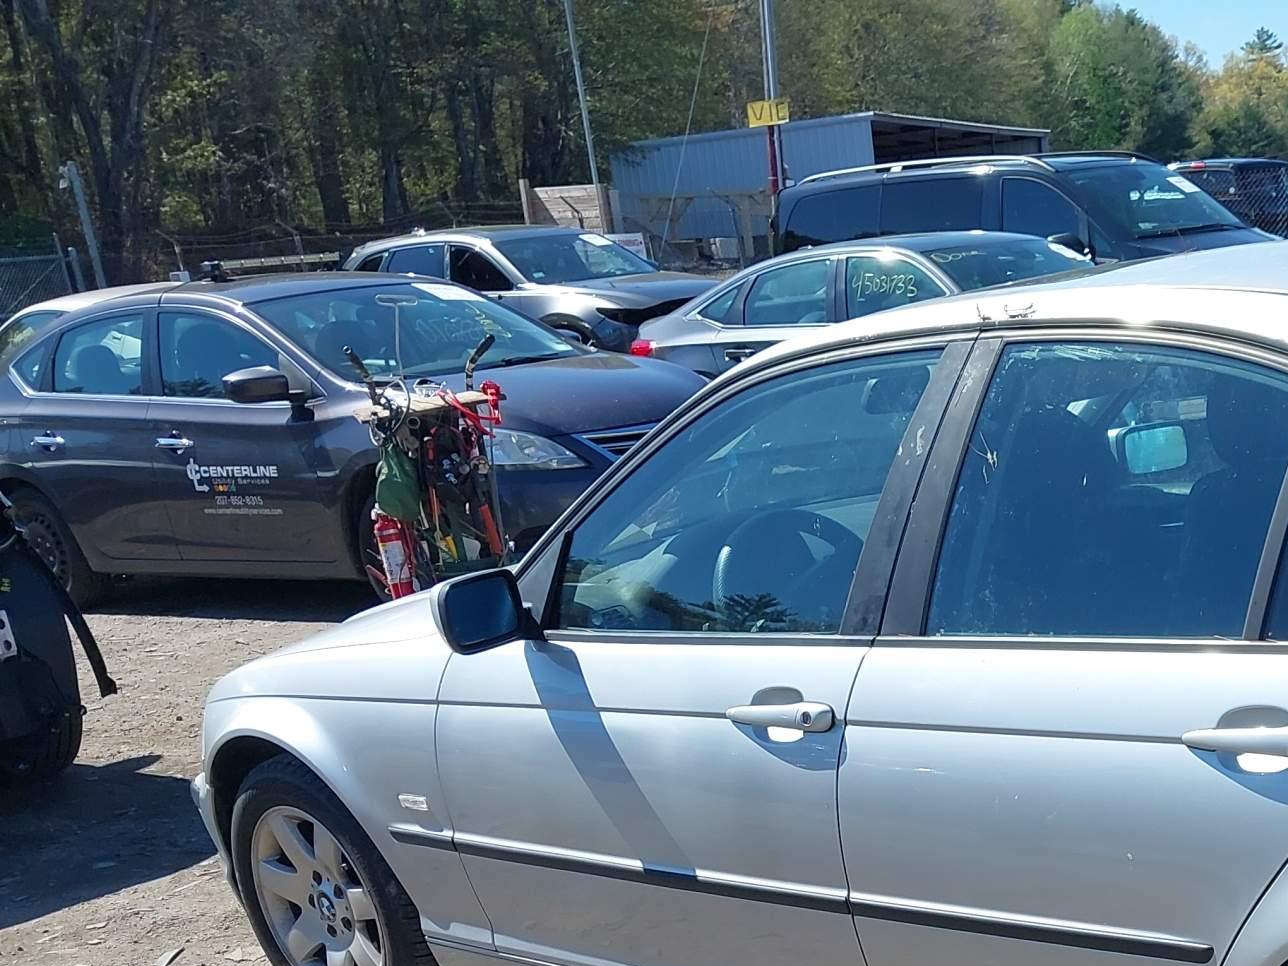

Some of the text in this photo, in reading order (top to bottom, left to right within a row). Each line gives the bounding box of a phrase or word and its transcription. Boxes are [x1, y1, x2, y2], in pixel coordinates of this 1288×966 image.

[851, 271, 918, 301] 45031733
[200, 465, 279, 477] CENTERLINE
[237, 478, 270, 486] Services
